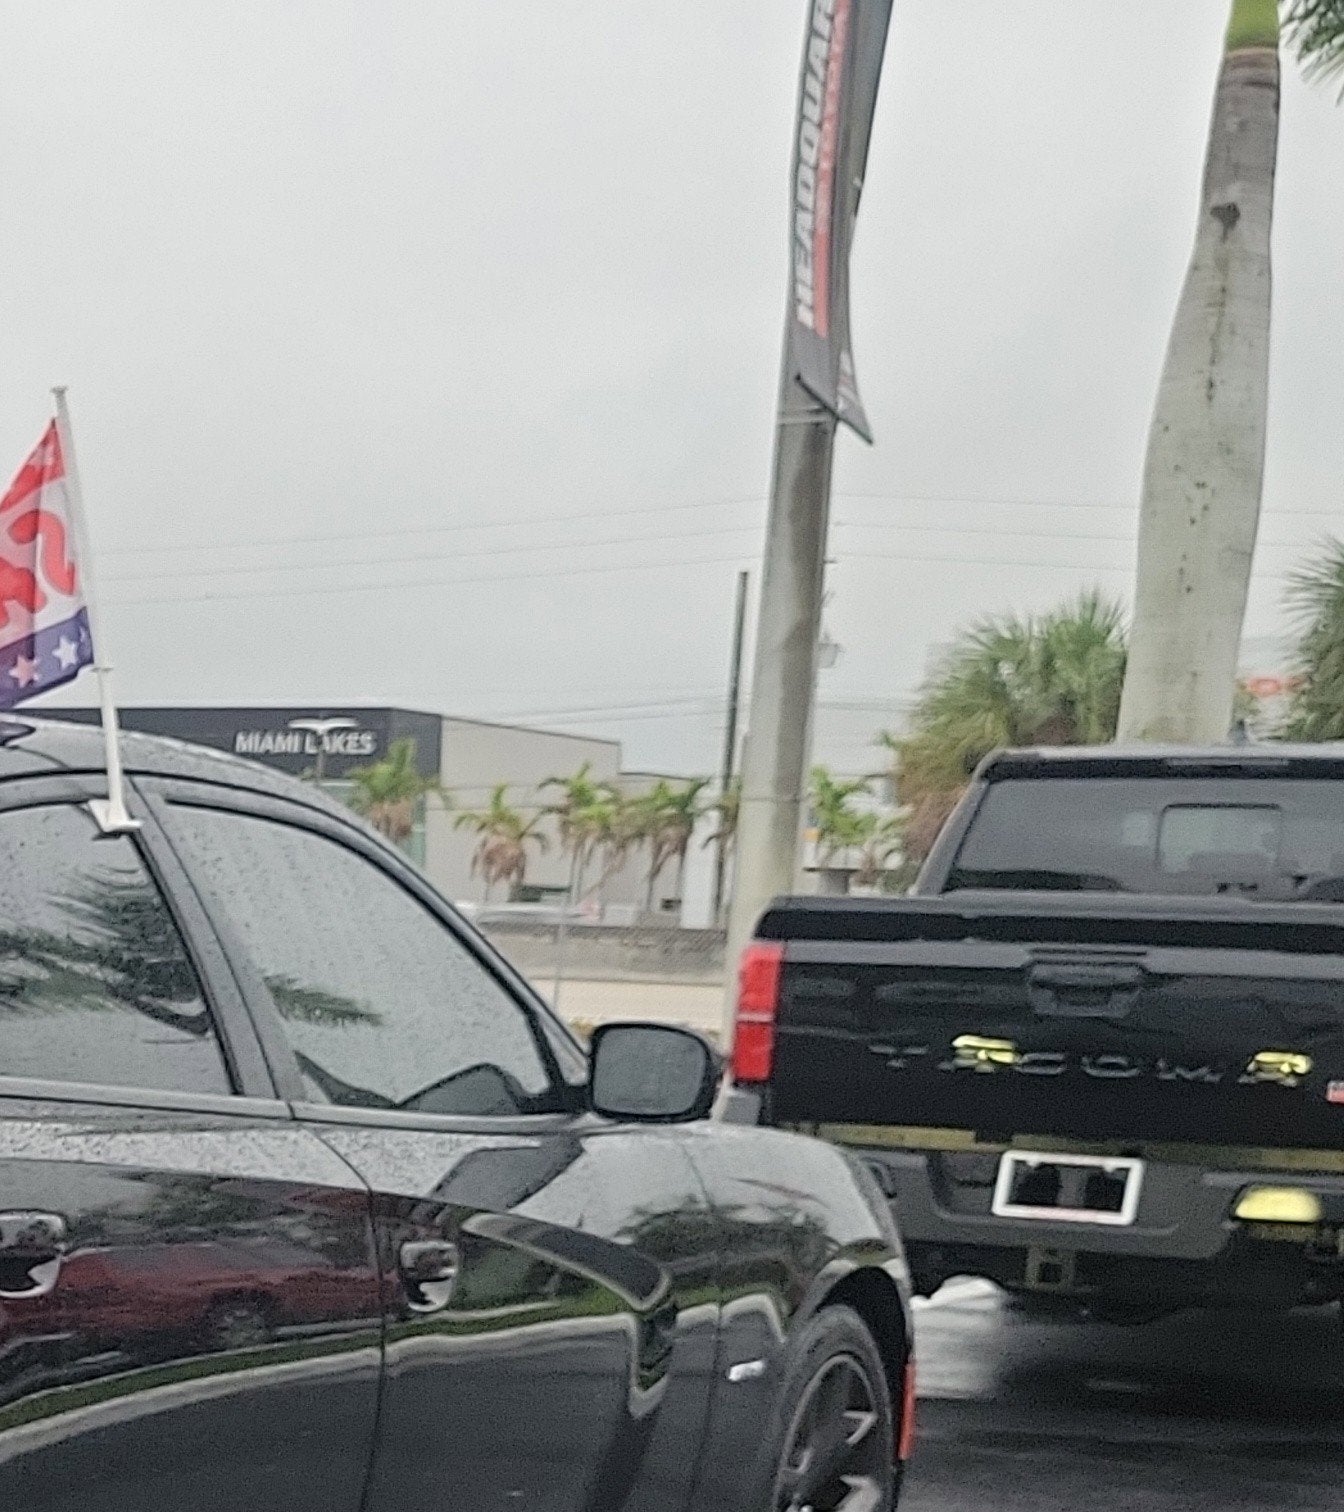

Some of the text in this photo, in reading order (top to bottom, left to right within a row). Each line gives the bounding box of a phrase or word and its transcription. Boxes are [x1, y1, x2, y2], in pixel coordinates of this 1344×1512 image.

[235, 731, 378, 755] MIAMI LAKES
[867, 1034, 1312, 1087] TACOMA
